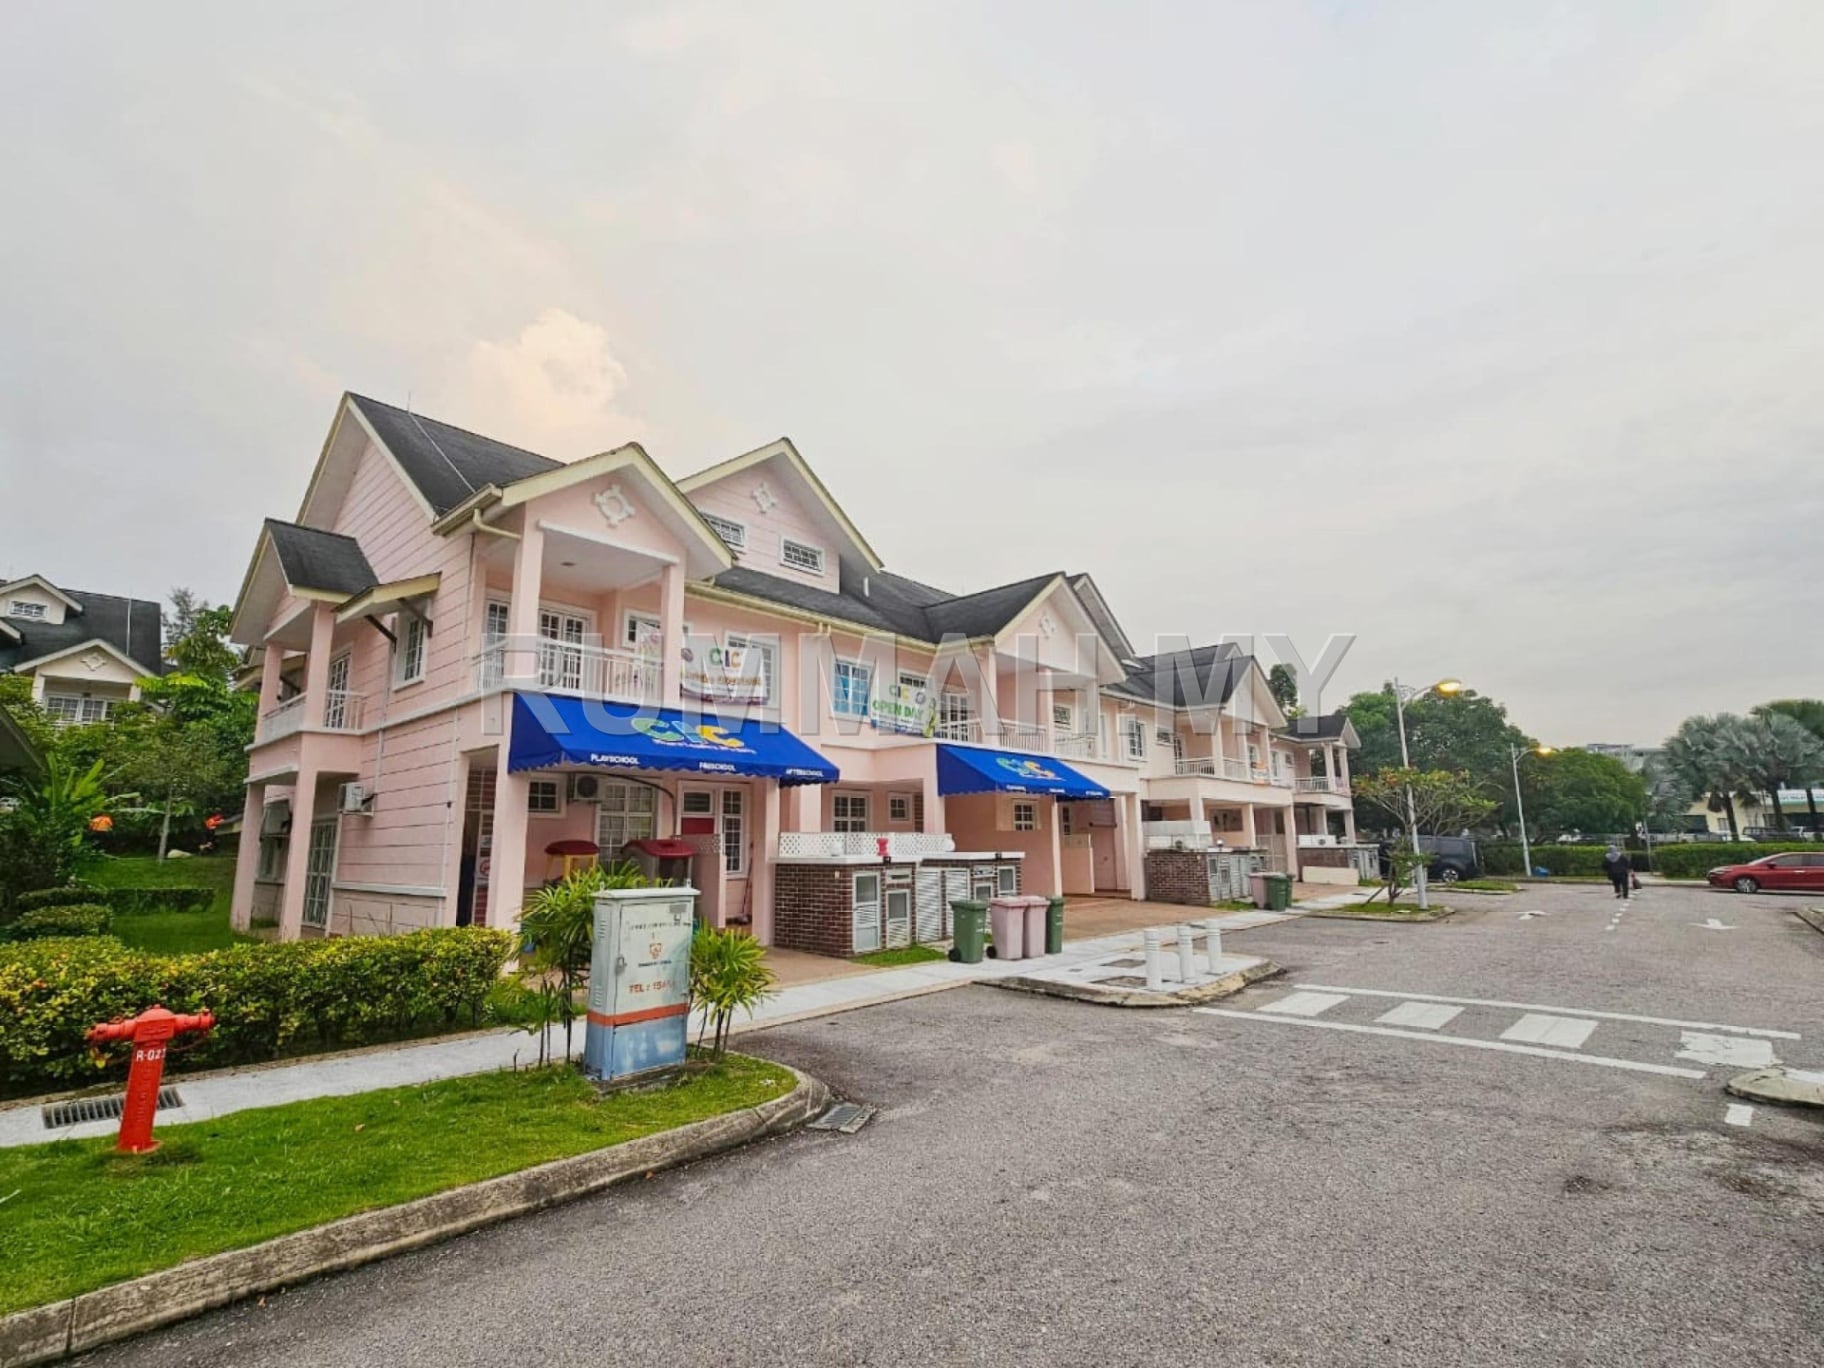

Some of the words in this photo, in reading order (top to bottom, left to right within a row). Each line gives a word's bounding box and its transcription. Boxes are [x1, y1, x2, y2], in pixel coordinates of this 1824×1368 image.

[709, 647, 742, 669] CIC
[872, 699, 901, 716] OPEN
[631, 717, 744, 748] CIC
[590, 752, 639, 765] PLAYSCHOOL
[699, 761, 736, 772] PRESCHOOL
[629, 982, 645, 993] TEL
